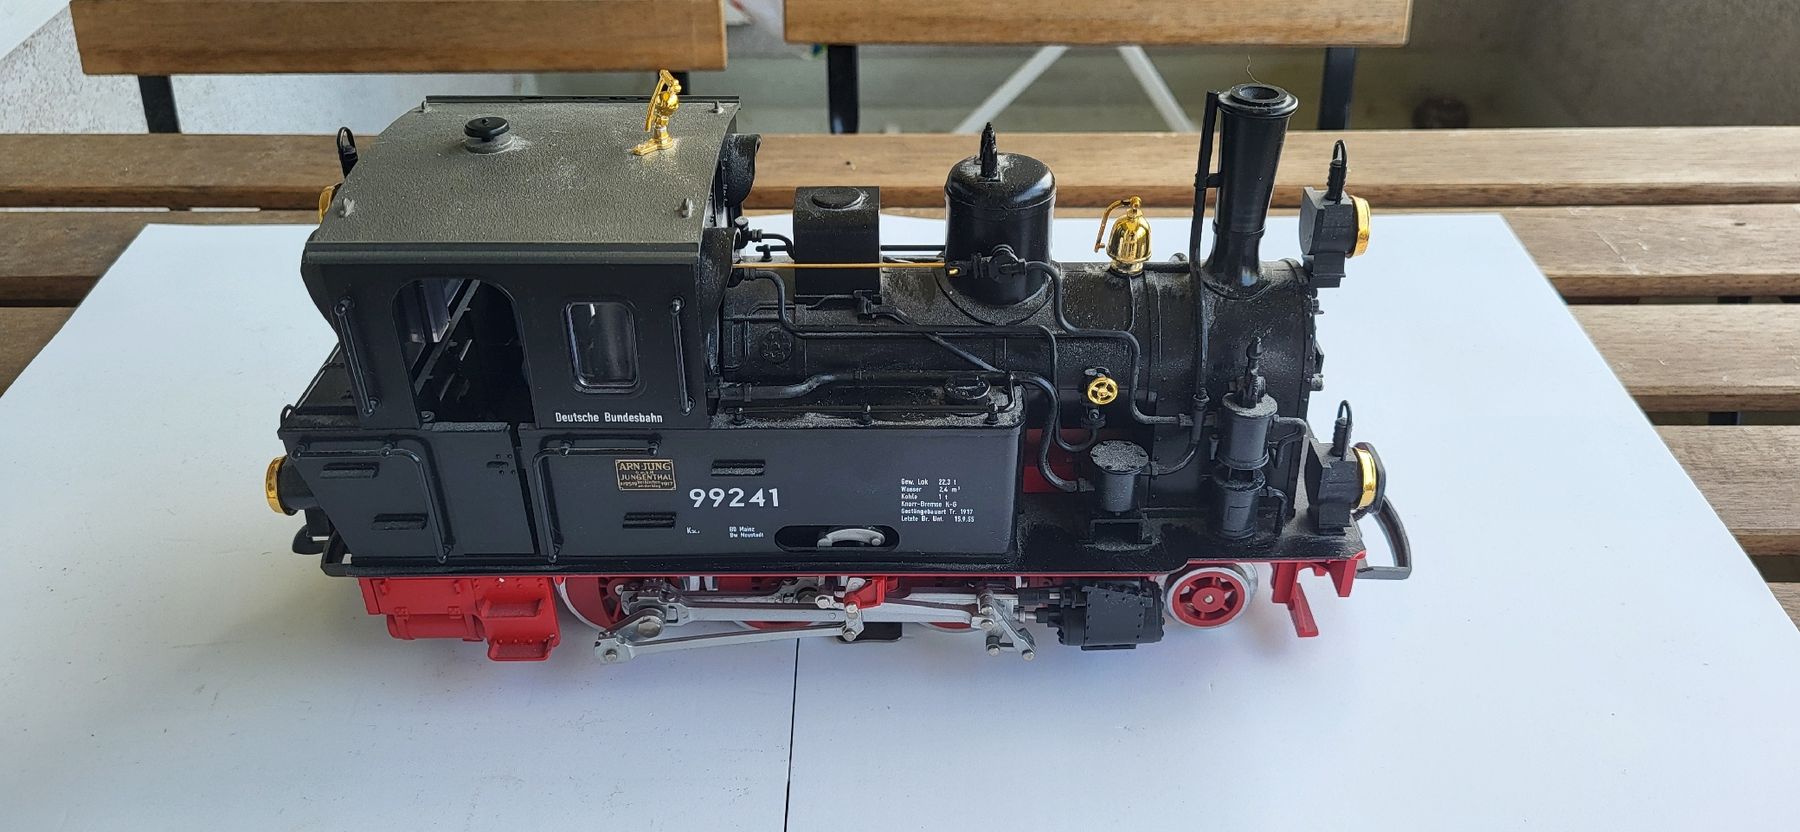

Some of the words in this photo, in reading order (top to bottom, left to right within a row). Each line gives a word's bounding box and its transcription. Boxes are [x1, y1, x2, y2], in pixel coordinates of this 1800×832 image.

[556, 412, 599, 422] Deutsche
[604, 412, 663, 423] Bundesbahn
[918, 478, 928, 486] Lok
[689, 487, 779, 508] 99241
